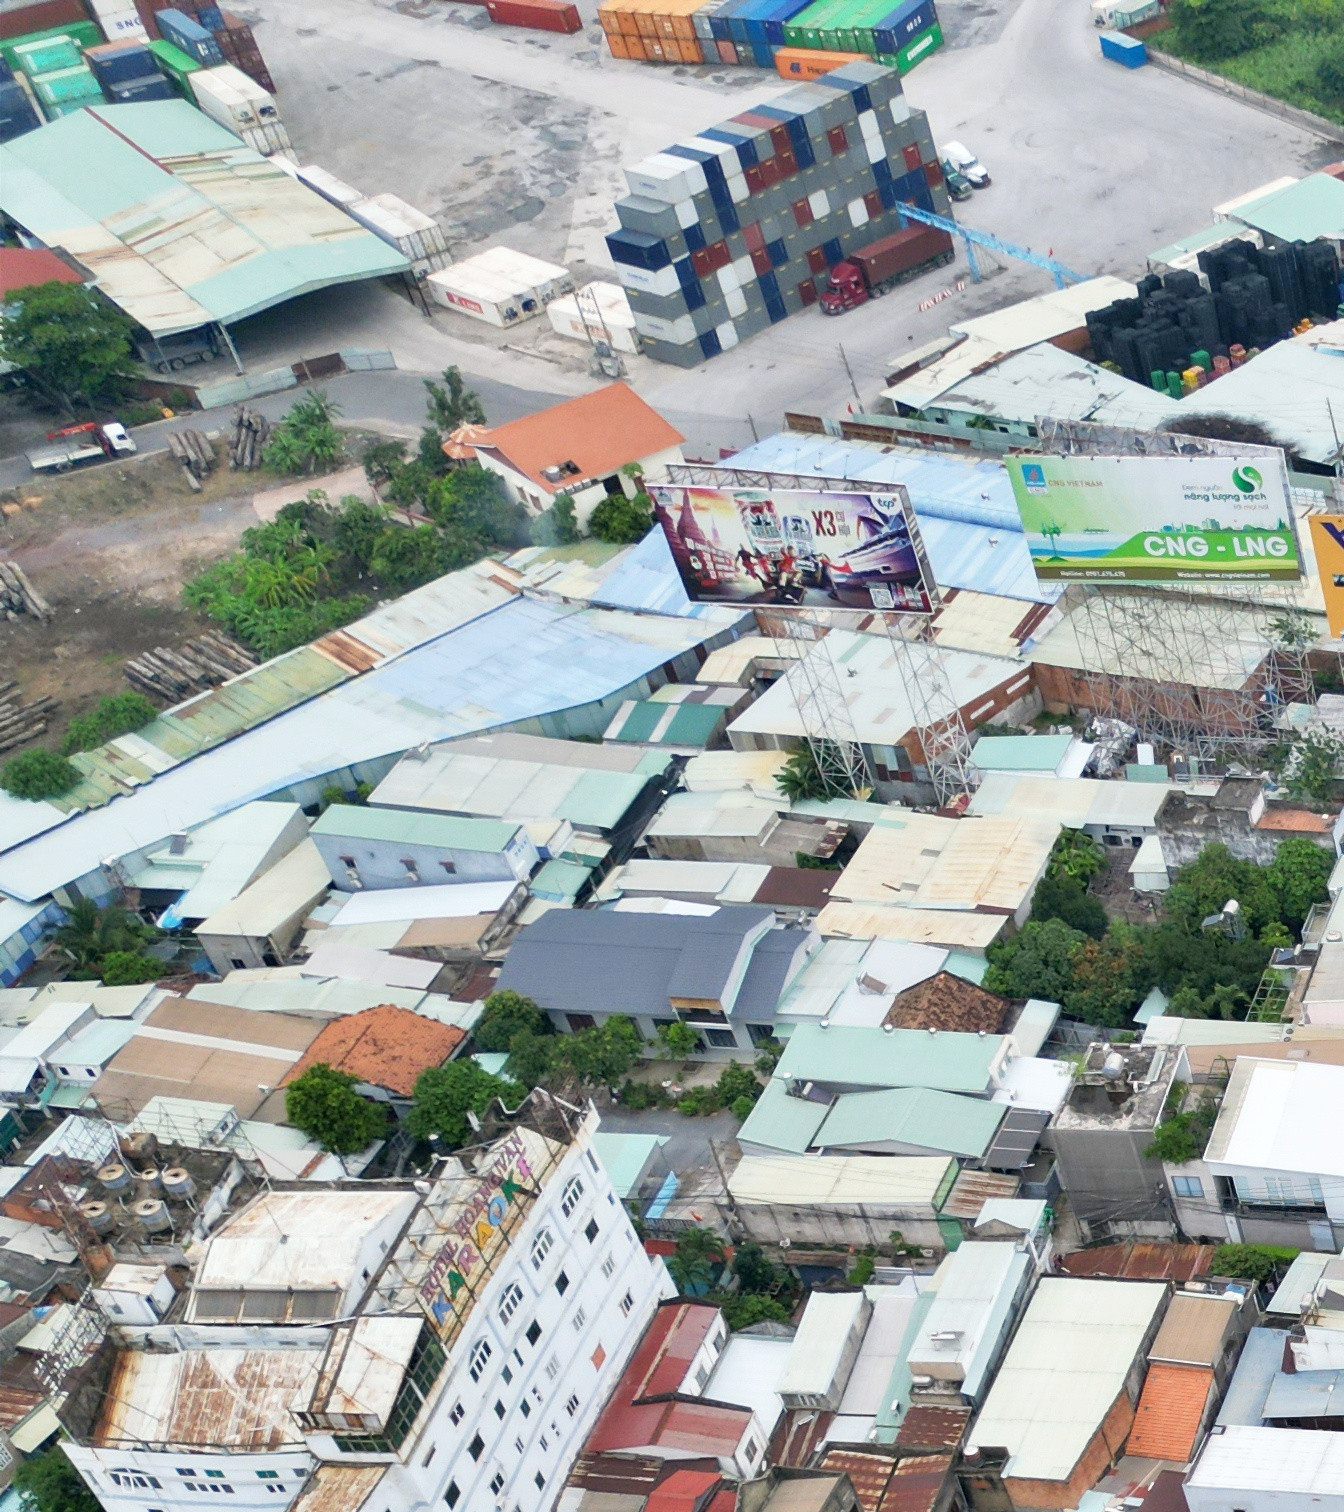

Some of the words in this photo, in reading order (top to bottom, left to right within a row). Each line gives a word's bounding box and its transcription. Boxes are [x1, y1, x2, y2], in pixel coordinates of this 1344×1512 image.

[811, 510, 837, 537] X3
[1143, 536, 1209, 557] CNG
[1232, 536, 1289, 557] LNG
